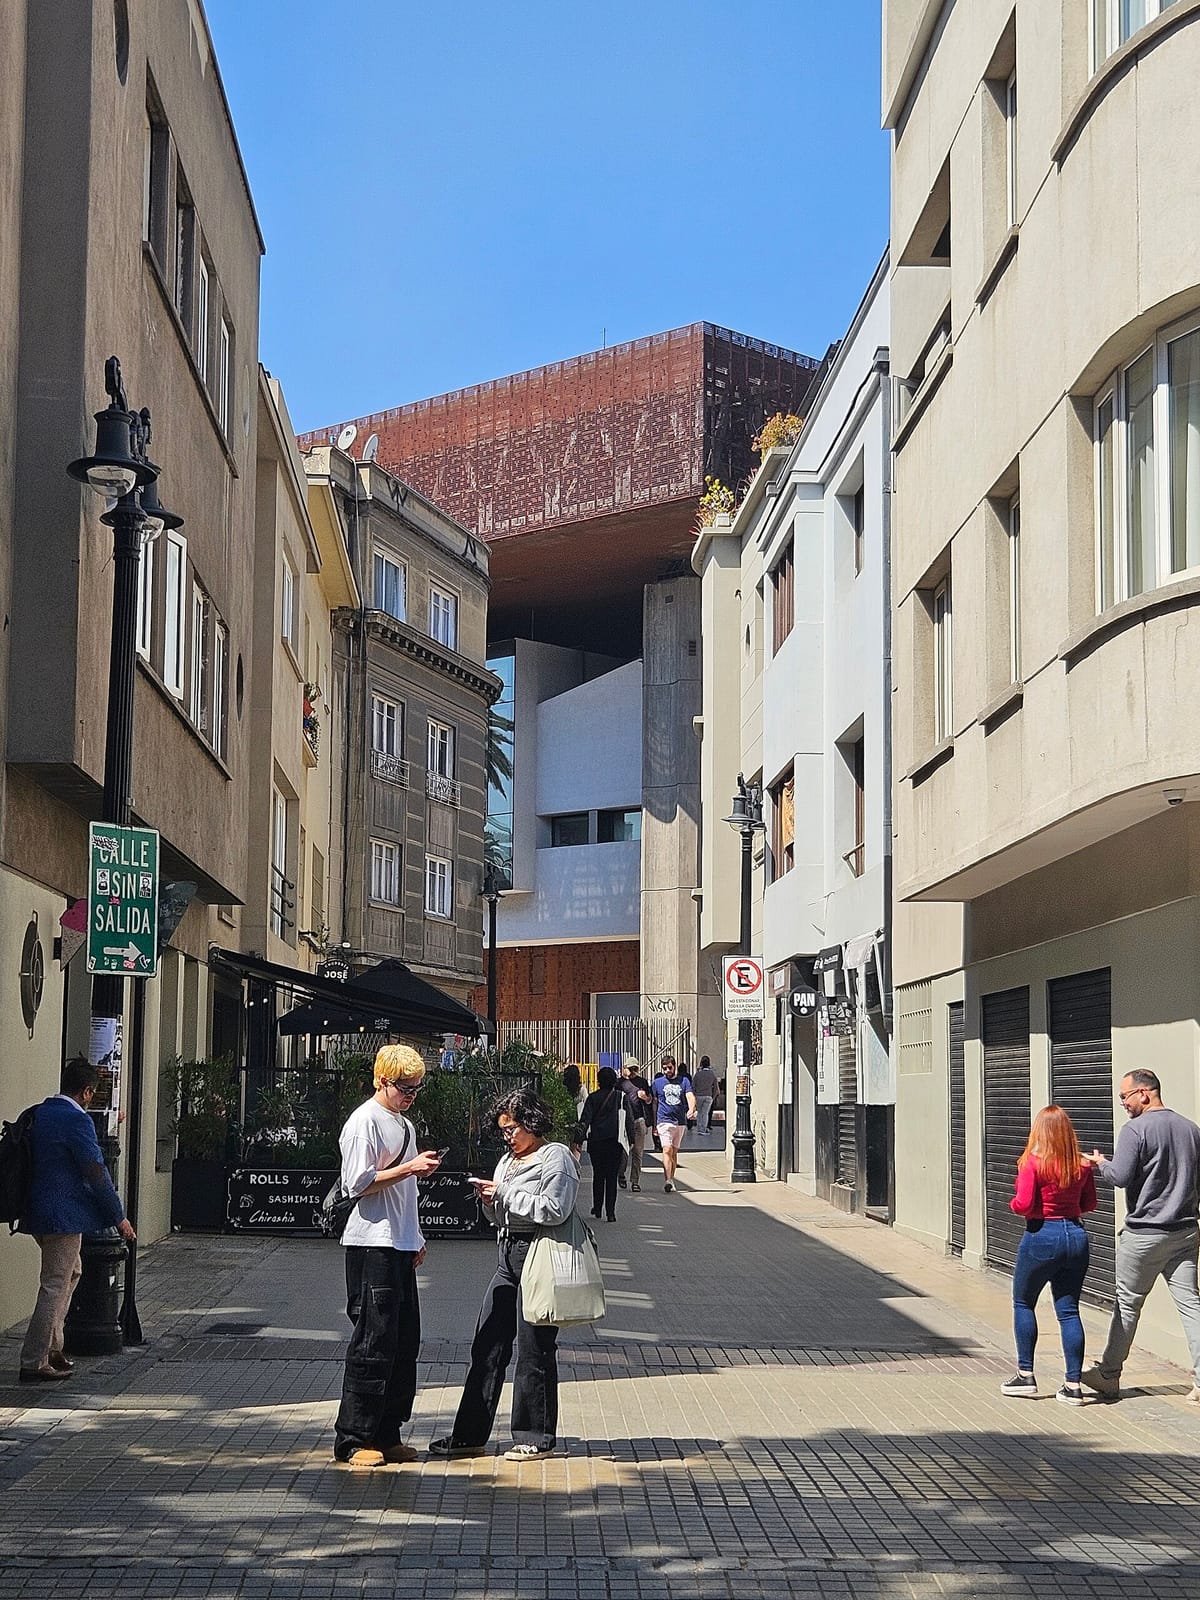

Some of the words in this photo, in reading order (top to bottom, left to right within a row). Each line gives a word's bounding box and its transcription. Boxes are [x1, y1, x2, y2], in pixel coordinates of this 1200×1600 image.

[100, 838, 149, 867] CALLE
[95, 904, 151, 935] SALIDA
[793, 992, 815, 1007] PAN
[249, 1174, 289, 1185] ROLLS
[439, 1176, 460, 1187] Otros
[268, 1195, 320, 1204] SASHIMIS
[420, 1215, 459, 1225] IQUEOS
